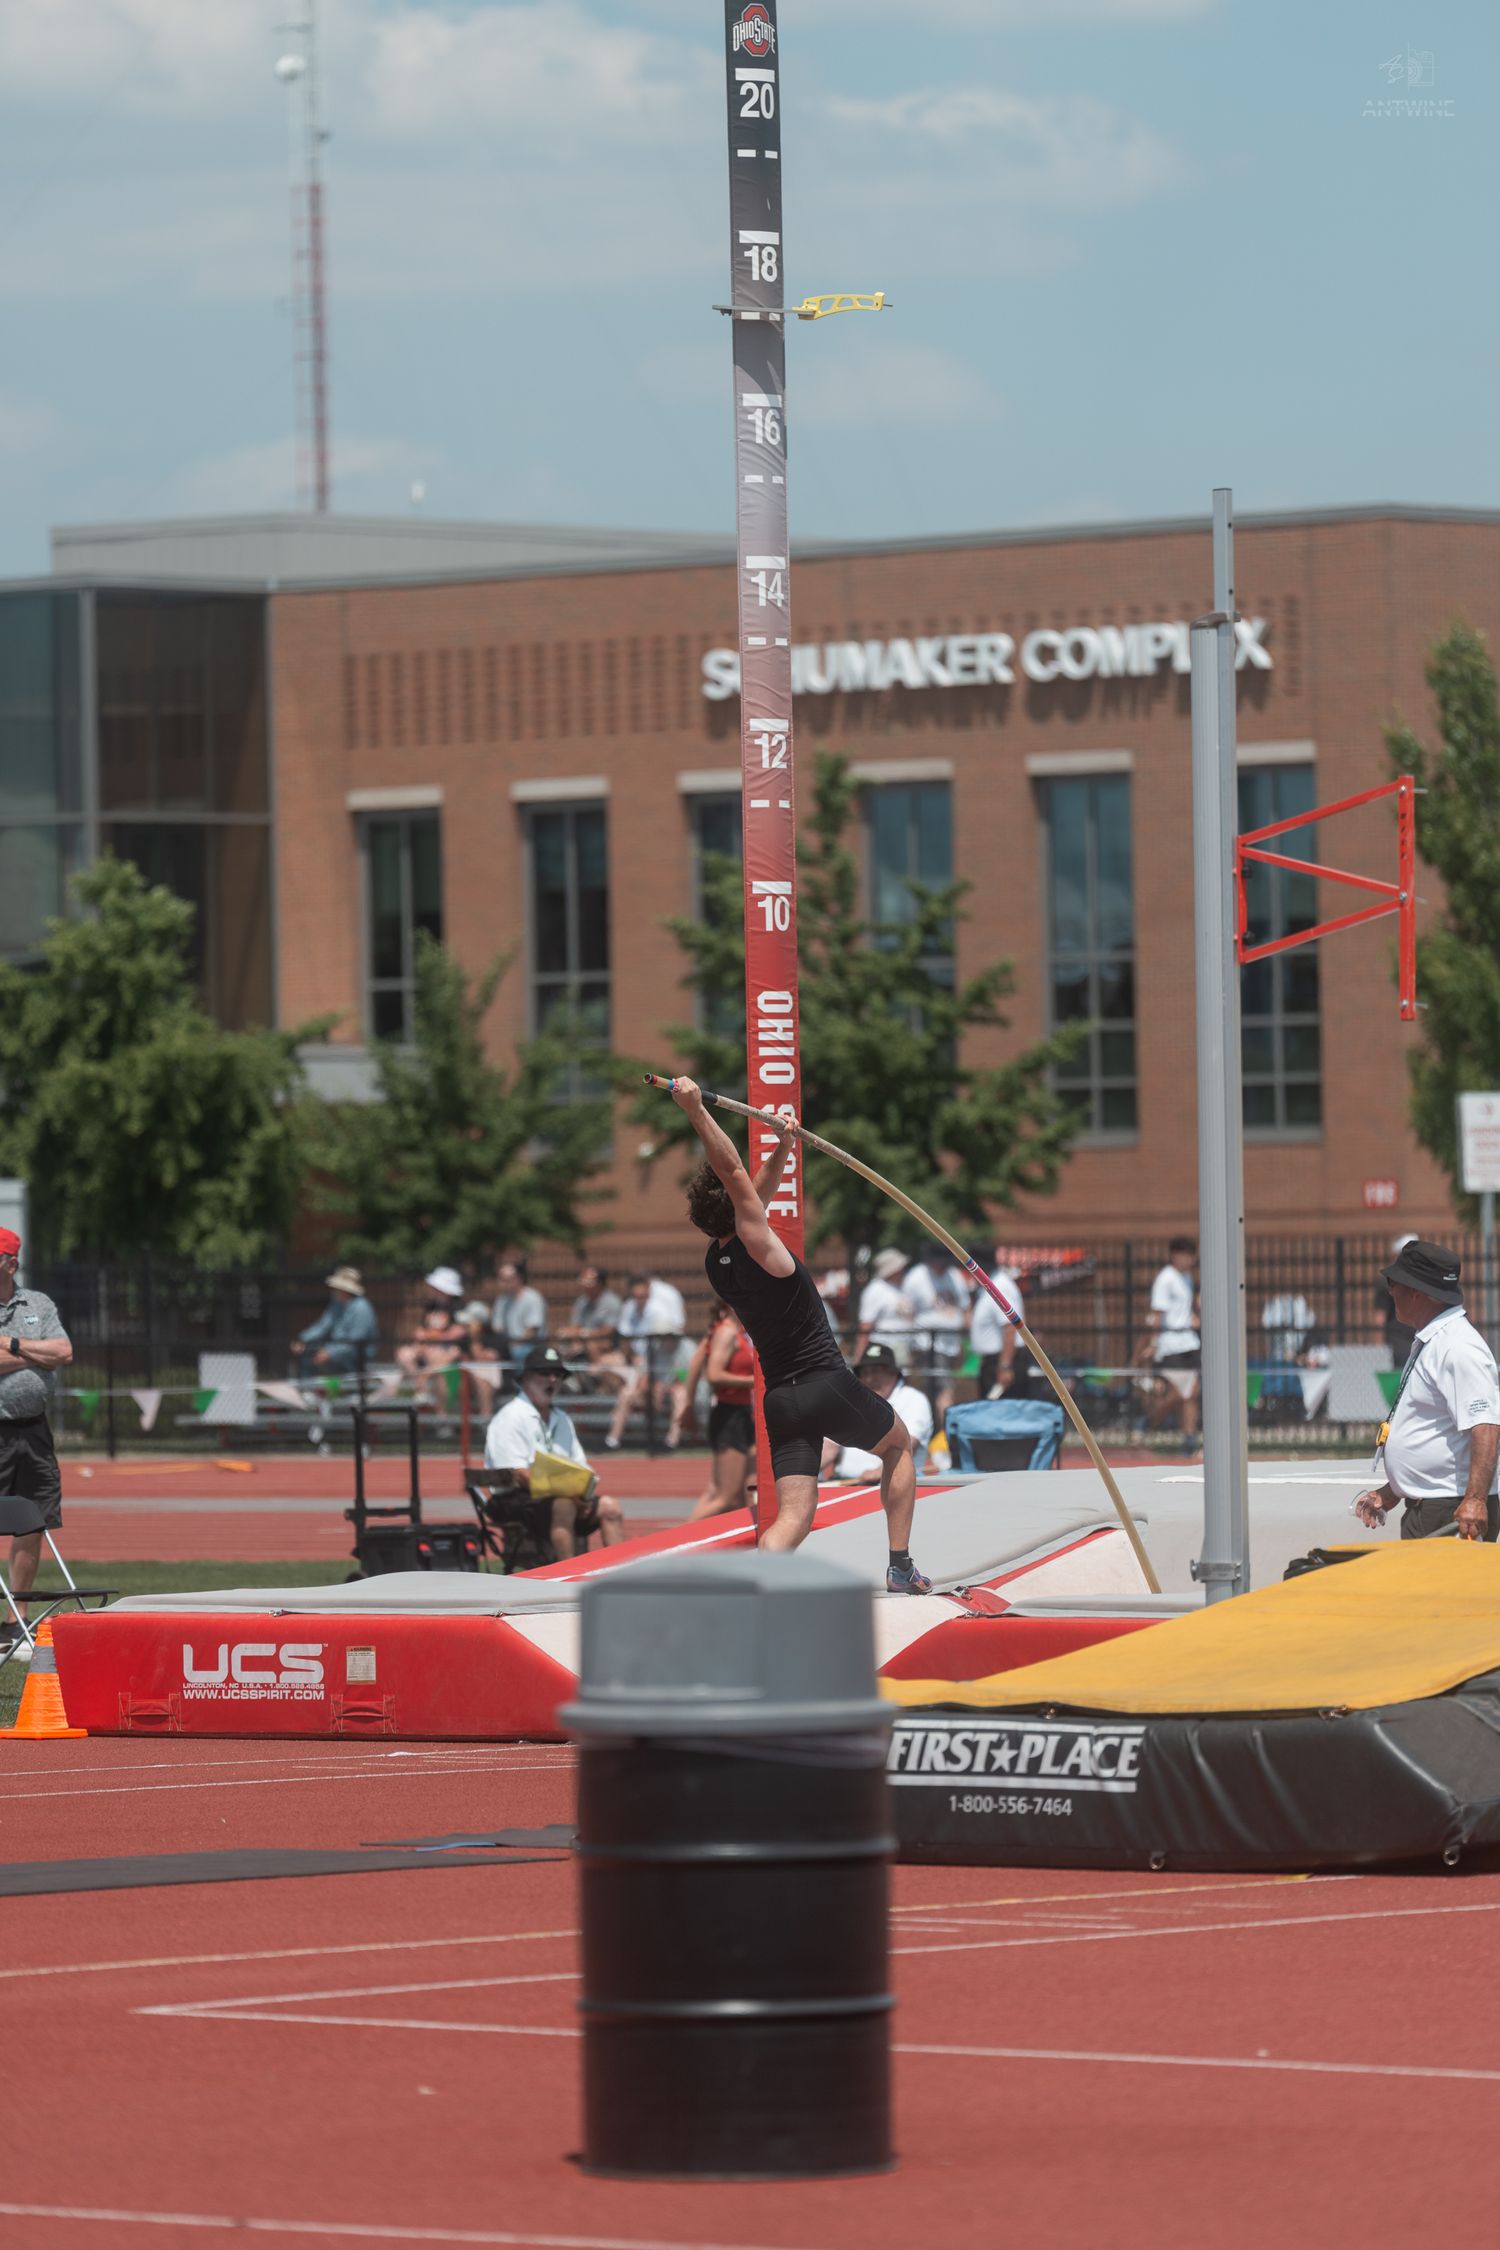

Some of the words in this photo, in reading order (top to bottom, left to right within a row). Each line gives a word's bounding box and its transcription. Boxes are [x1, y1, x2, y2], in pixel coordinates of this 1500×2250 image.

[740, 82, 774, 119] 20
[744, 245, 778, 283] 18
[747, 408, 781, 445] 16
[750, 571, 784, 607] 14
[702, 632, 1015, 700] SUMAKER
[1021, 618, 1274, 682] COMPLX
[754, 733, 787, 768] 12
[757, 895, 790, 932] 10
[757, 990, 795, 1085] OHIO
[183, 1643, 324, 1683] UCS
[183, 1689, 324, 1700] WWW.UCSSPIRIT.COM
[885, 1730, 999, 1773] FIRST
[1014, 1734, 1144, 1778] PLACE
[949, 1795, 1072, 1816] 1-800-556-7464
